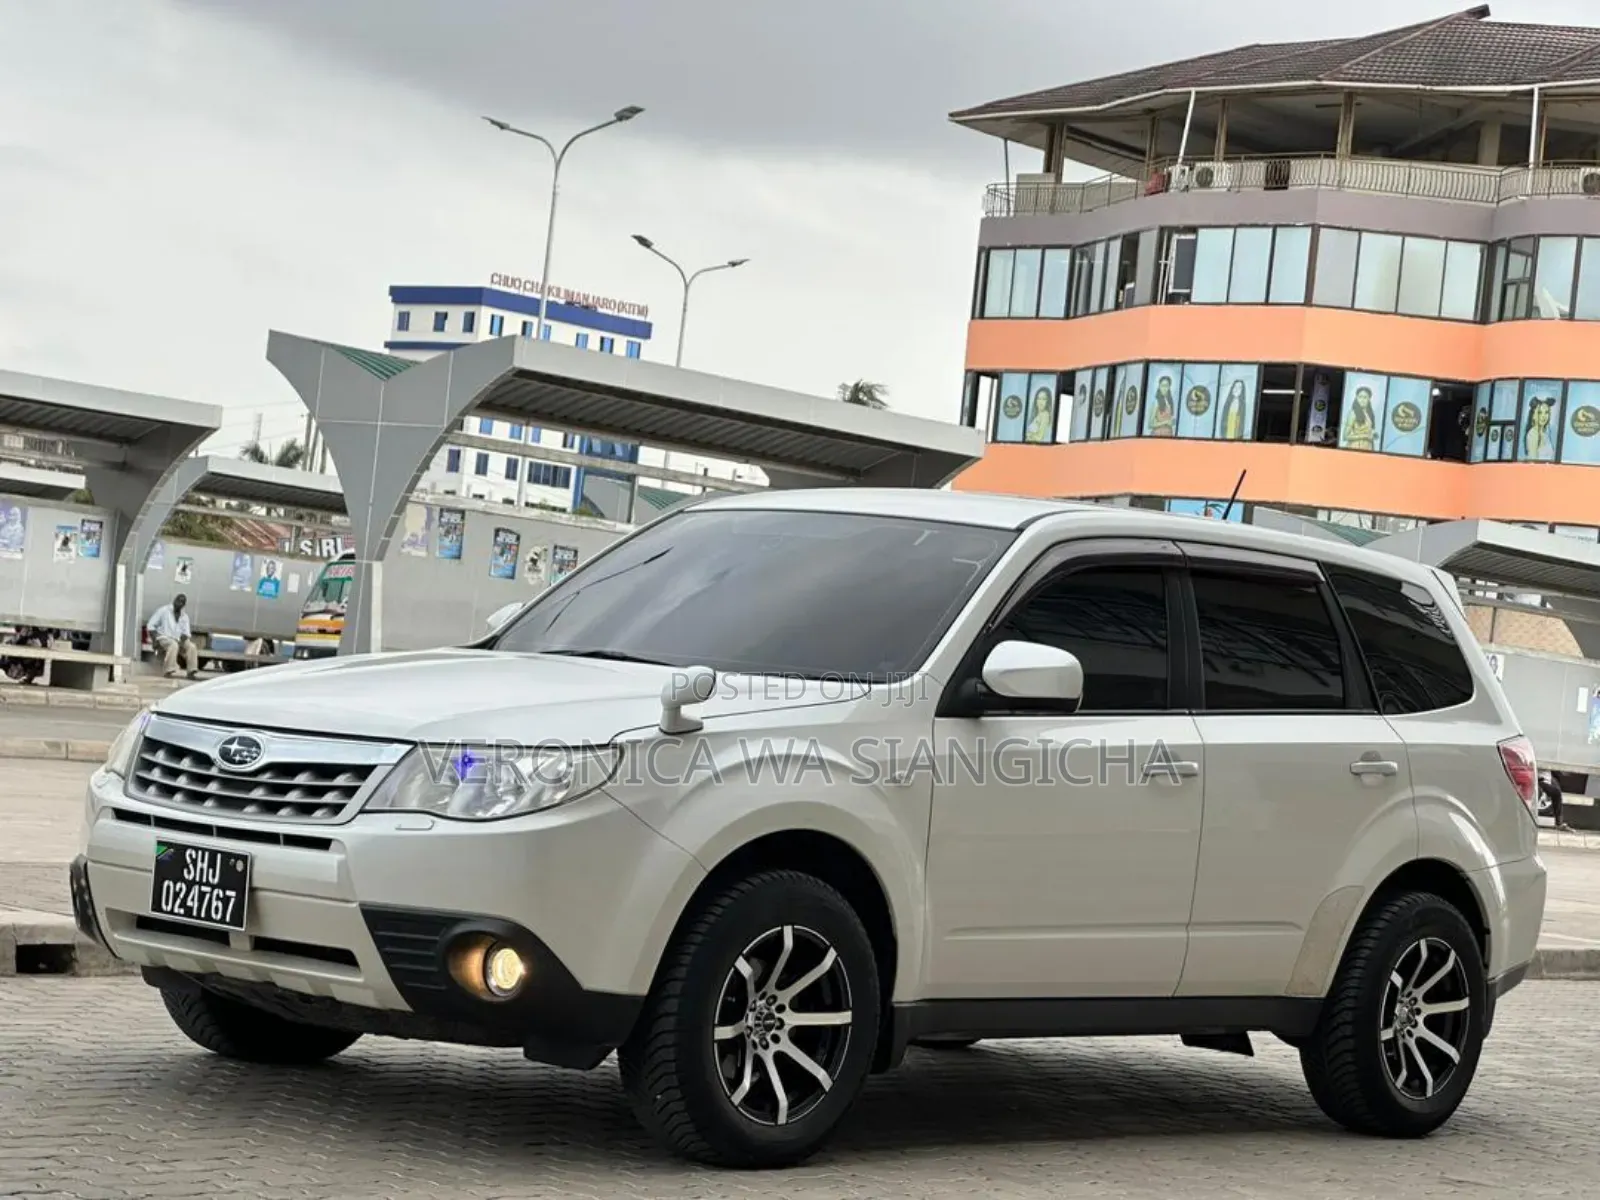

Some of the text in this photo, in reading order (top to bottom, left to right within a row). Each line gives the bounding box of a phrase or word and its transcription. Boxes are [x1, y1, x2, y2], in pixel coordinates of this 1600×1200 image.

[491, 272, 522, 289] CHUO
[183, 848, 221, 884] SHJ
[161, 880, 236, 922] 024767
